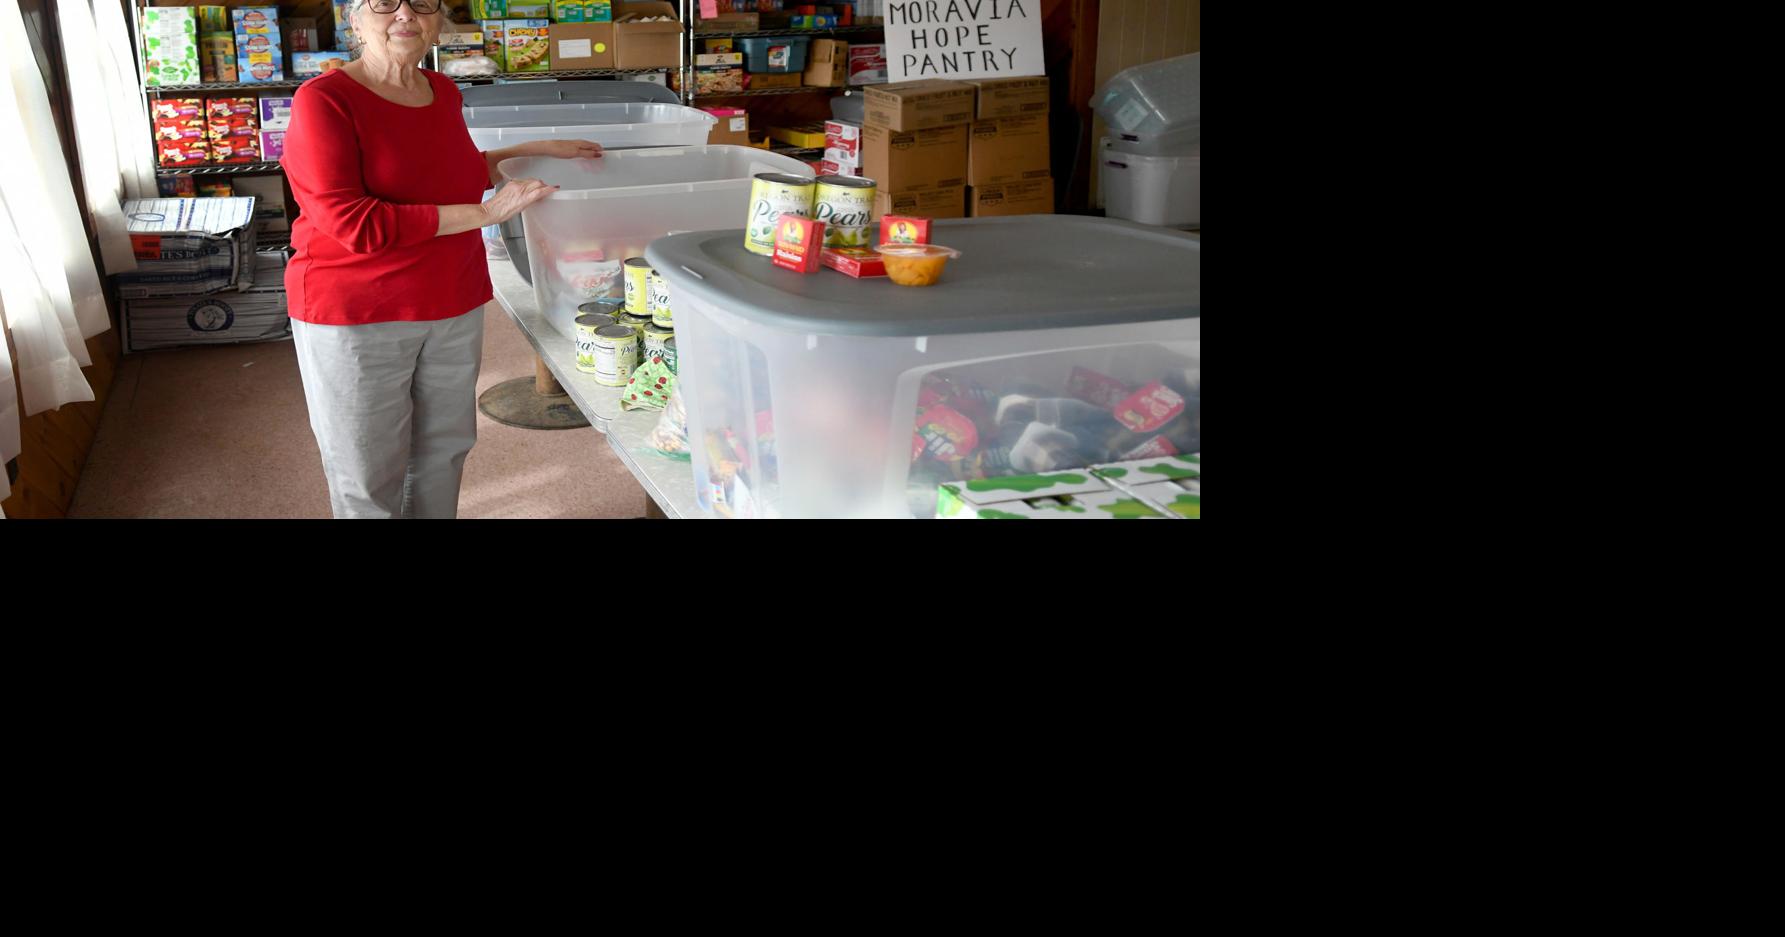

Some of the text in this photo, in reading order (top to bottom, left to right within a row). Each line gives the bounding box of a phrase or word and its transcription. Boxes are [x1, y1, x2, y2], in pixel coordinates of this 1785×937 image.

[889, 0, 1027, 25] MORAVIA
[911, 24, 992, 49] HOPE
[903, 47, 1017, 77] PANTRY
[815, 201, 871, 226] Pears
